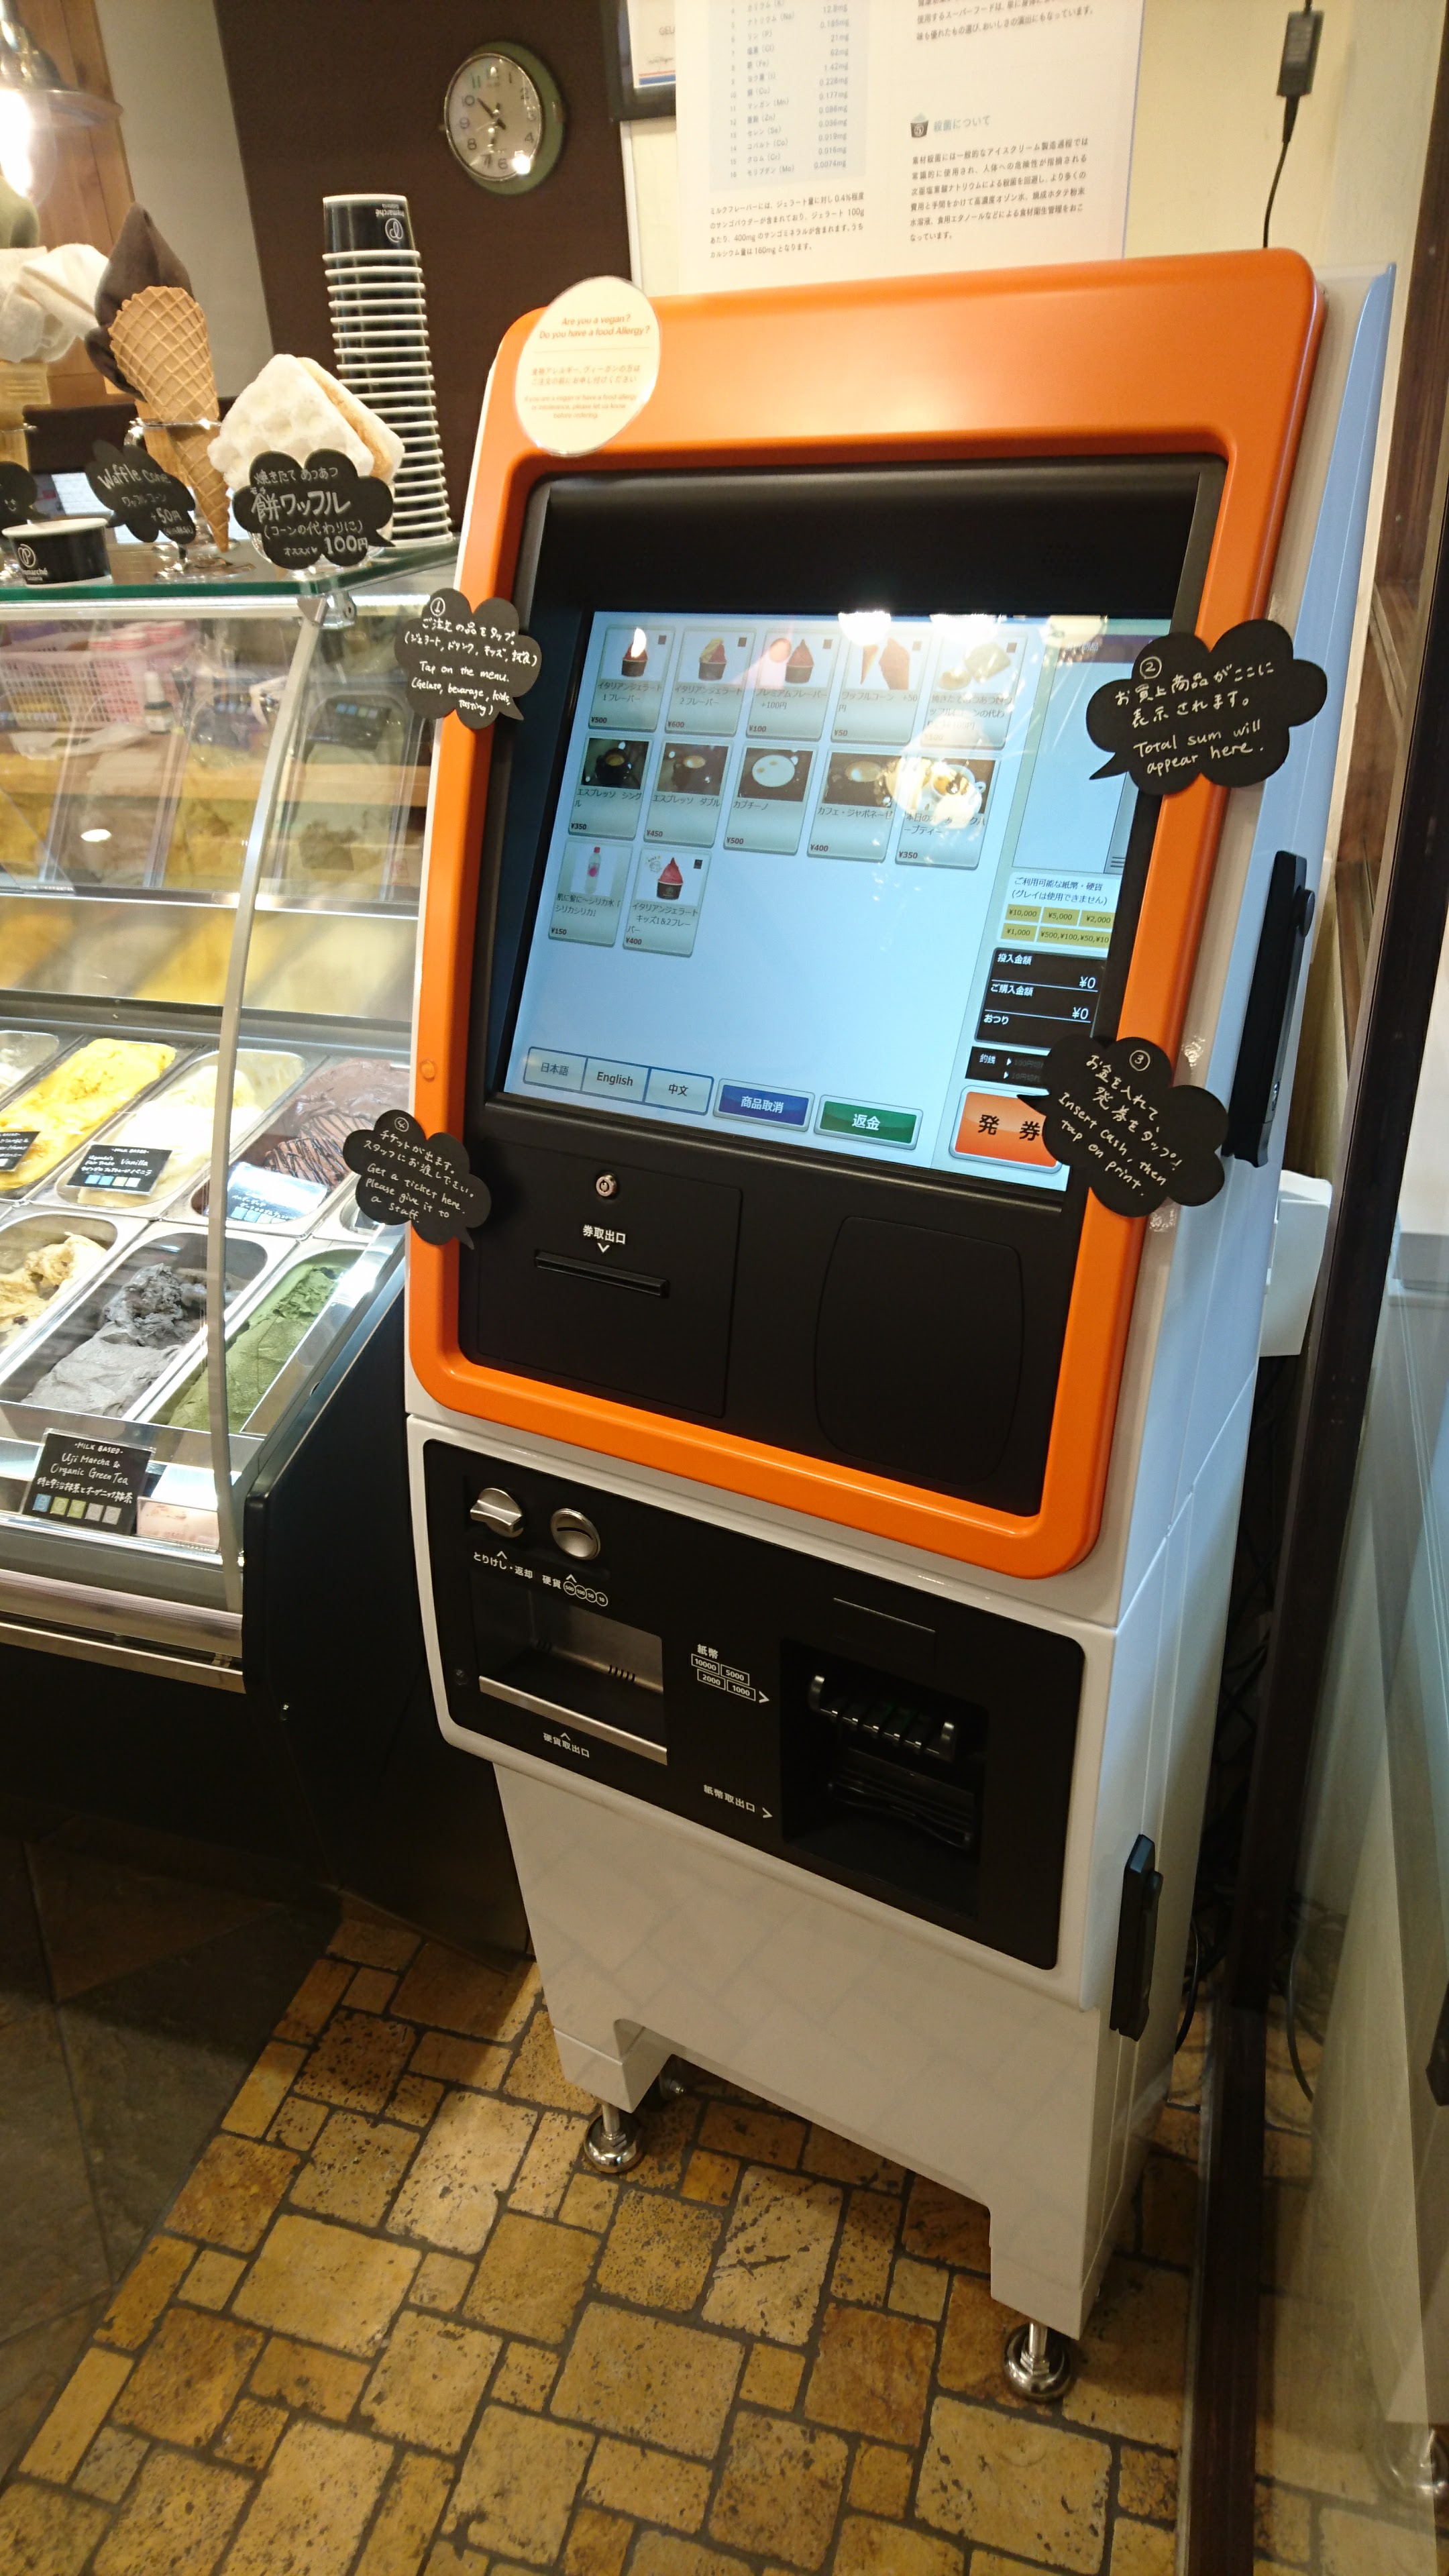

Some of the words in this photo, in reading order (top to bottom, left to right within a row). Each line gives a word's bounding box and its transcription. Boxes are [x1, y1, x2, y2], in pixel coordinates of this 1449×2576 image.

[561, 317, 575, 326] Are
[577, 318, 592, 327] you
[539, 331, 550, 339] Do
[551, 331, 566, 340] you
[568, 329, 587, 337] have
[596, 327, 614, 335] food
[97, 464, 142, 490] Waffle
[142, 469, 172, 484] Cone
[251, 490, 351, 524] 餅ワッフル
[324, 535, 369, 555] 100円
[419, 661, 436, 674] Tap
[441, 665, 453, 674] on
[460, 666, 474, 676] the
[480, 670, 510, 682] menu.
[1115, 661, 1275, 706] お買上商品がここに
[1132, 690, 1250, 729] 表示されます。
[1132, 735, 1178, 759] Total
[1187, 731, 1222, 747] sum
[1233, 718, 1261, 739] will
[1146, 754, 1198, 777] appear
[1210, 741, 1264, 760] here.
[571, 822, 587, 830] ¥350
[646, 829, 663, 837] ¥450
[727, 837, 744, 845] ¥500
[810, 843, 828, 852] ¥400
[898, 851, 918, 859] ¥350
[1009, 908, 1038, 918] ¥10,000
[1048, 912, 1073, 922] ¥5,000
[1085, 914, 1112, 924] ¥2,000
[551, 927, 567, 935] ¥150
[1006, 927, 1031, 937] ¥1,000
[625, 937, 642, 945] ¥400
[997, 952, 1032, 966] 投入金額
[1079, 975, 1097, 989] ¥0
[983, 1013, 1010, 1026] おつり
[1072, 1006, 1089, 1020] ¥0
[540, 1062, 570, 1077] 日本語
[596, 1071, 633, 1087] English
[667, 1083, 689, 1097] 中文
[740, 1095, 784, 1114] 商品取消
[852, 1113, 881, 1132] 返金
[1058, 1091, 1098, 1130] Insert
[1140, 1160, 1167, 1186] then
[1061, 1119, 1083, 1142] tap
[1088, 1143, 1105, 1159] on
[120, 1159, 148, 1167] Vanilla
[367, 1163, 386, 1177] Get
[405, 1179, 437, 1199] ticket
[371, 1195, 382, 1203] a
[398, 1192, 419, 1205] give
[423, 1201, 433, 1213] it
[438, 1210, 449, 1218] to
[582, 1224, 627, 1245] 券取出口
[61, 1452, 78, 1465] Uji
[80, 1454, 111, 1466] Matcha
[50, 1462, 85, 1477] Organic
[89, 1467, 112, 1481] Green
[112, 1472, 129, 1486] Tea
[474, 1552, 533, 1578] とりけし・返却
[541, 1574, 561, 1589] 硬貨
[697, 1644, 718, 1660] 紙幣
[694, 1658, 716, 1671] 10000
[725, 1670, 745, 1681] 5000
[702, 1674, 721, 1686] 2000
[732, 1685, 751, 1697] 1000
[543, 1731, 590, 1759] 硬貨取出口
[703, 1783, 756, 1813] 紙幣取出口
